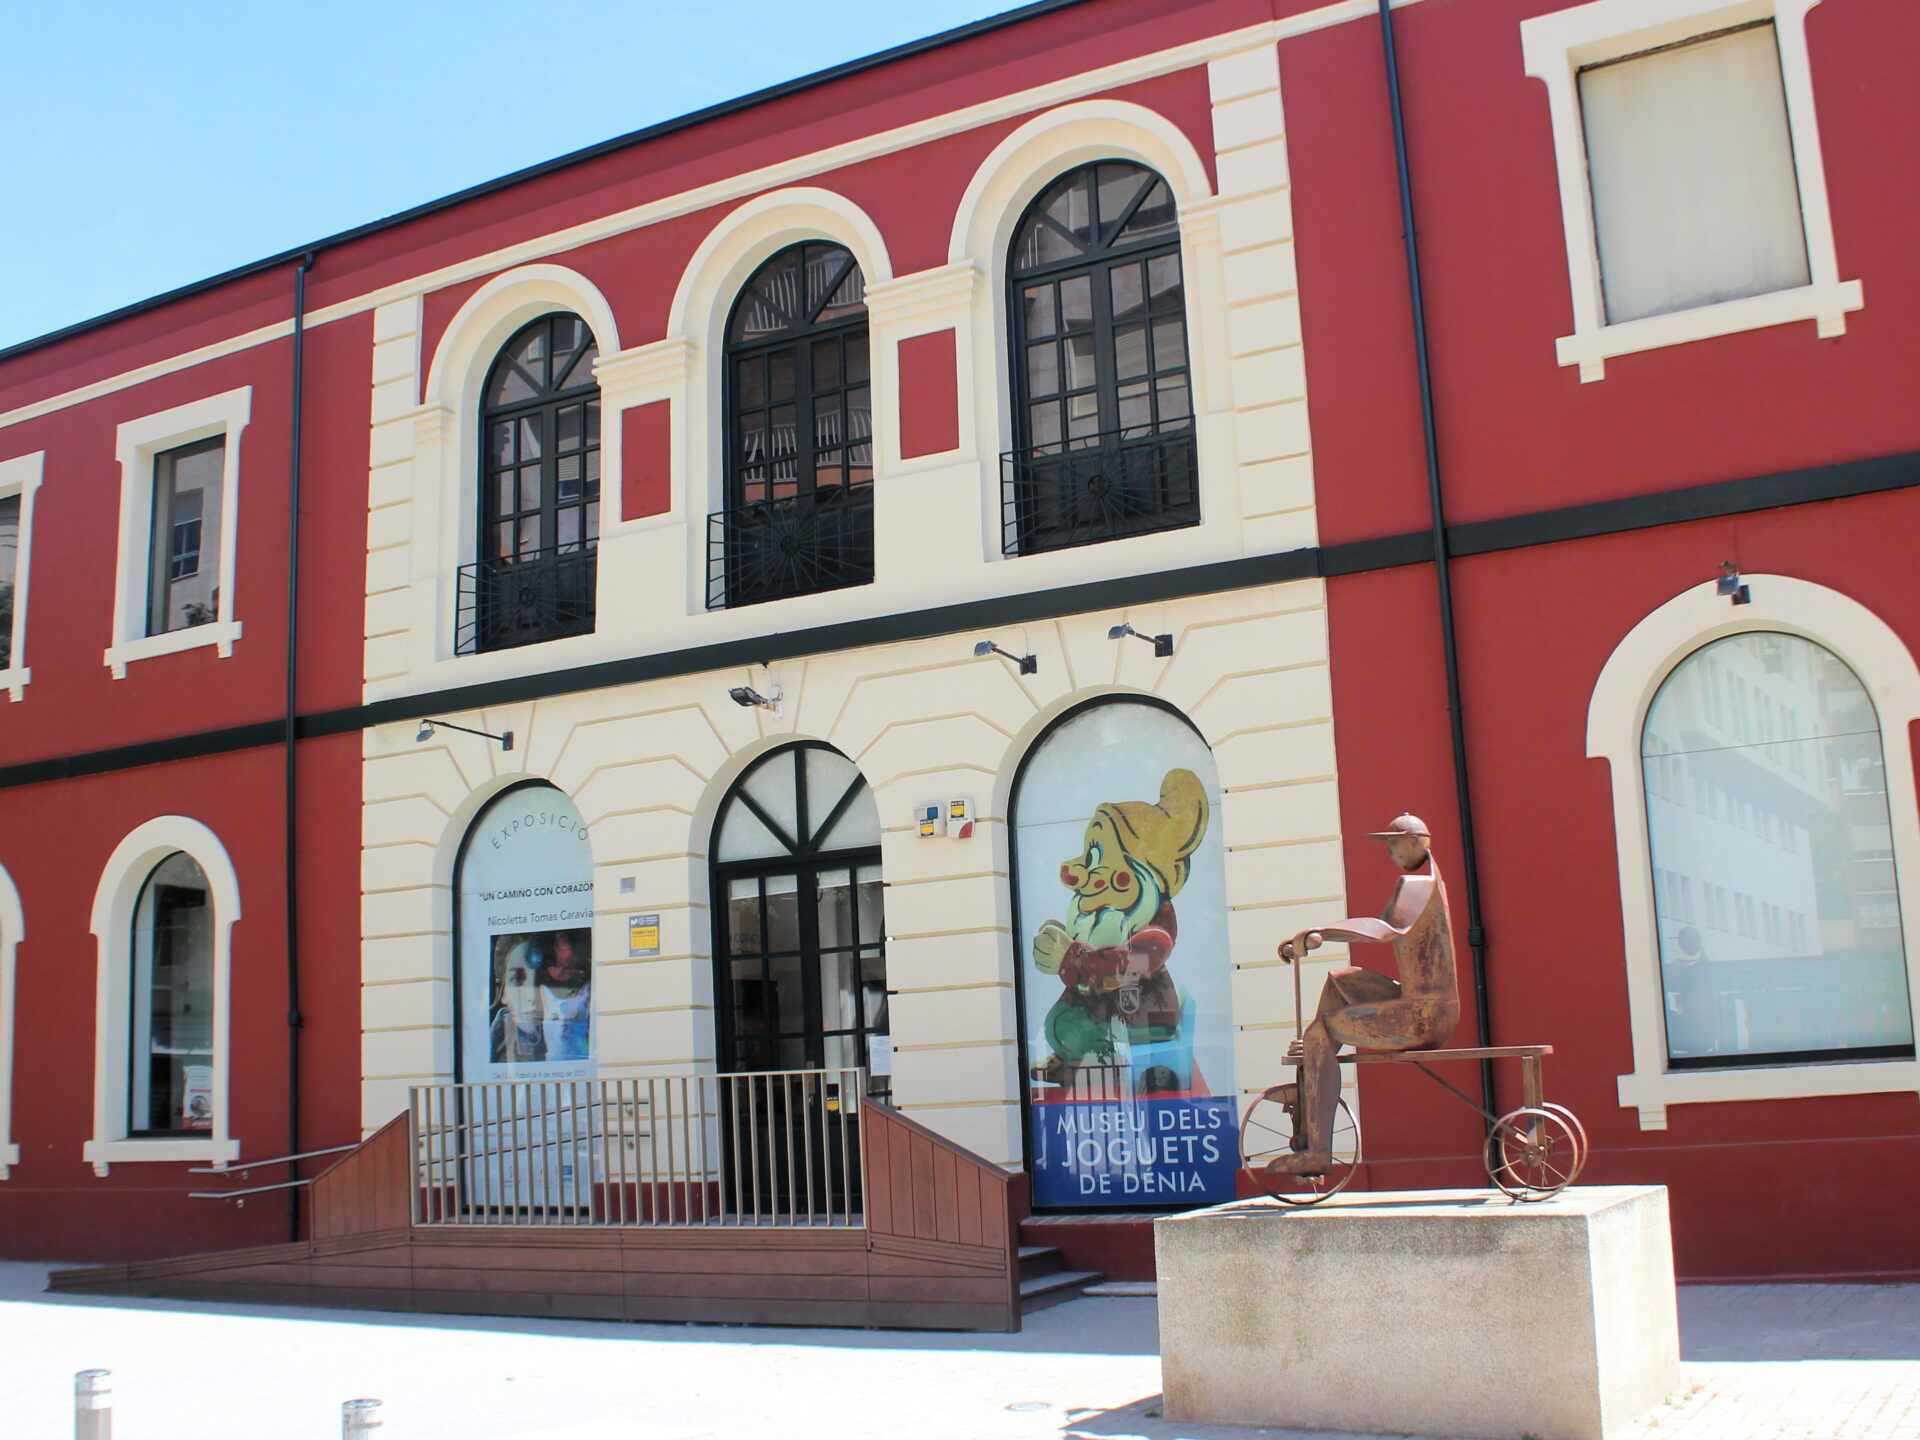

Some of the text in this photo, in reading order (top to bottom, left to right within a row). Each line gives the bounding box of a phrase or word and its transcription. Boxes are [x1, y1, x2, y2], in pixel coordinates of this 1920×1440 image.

[497, 889, 532, 900] CAMINO
[534, 887, 553, 896] CON
[488, 914, 528, 926] Nicoletta
[560, 908, 594, 920] Caravia
[1056, 1107, 1221, 1135] MUSEU DELS
[1061, 1134, 1220, 1168] JOGUETS
[1079, 1167, 1206, 1195] DE DÉNIA
